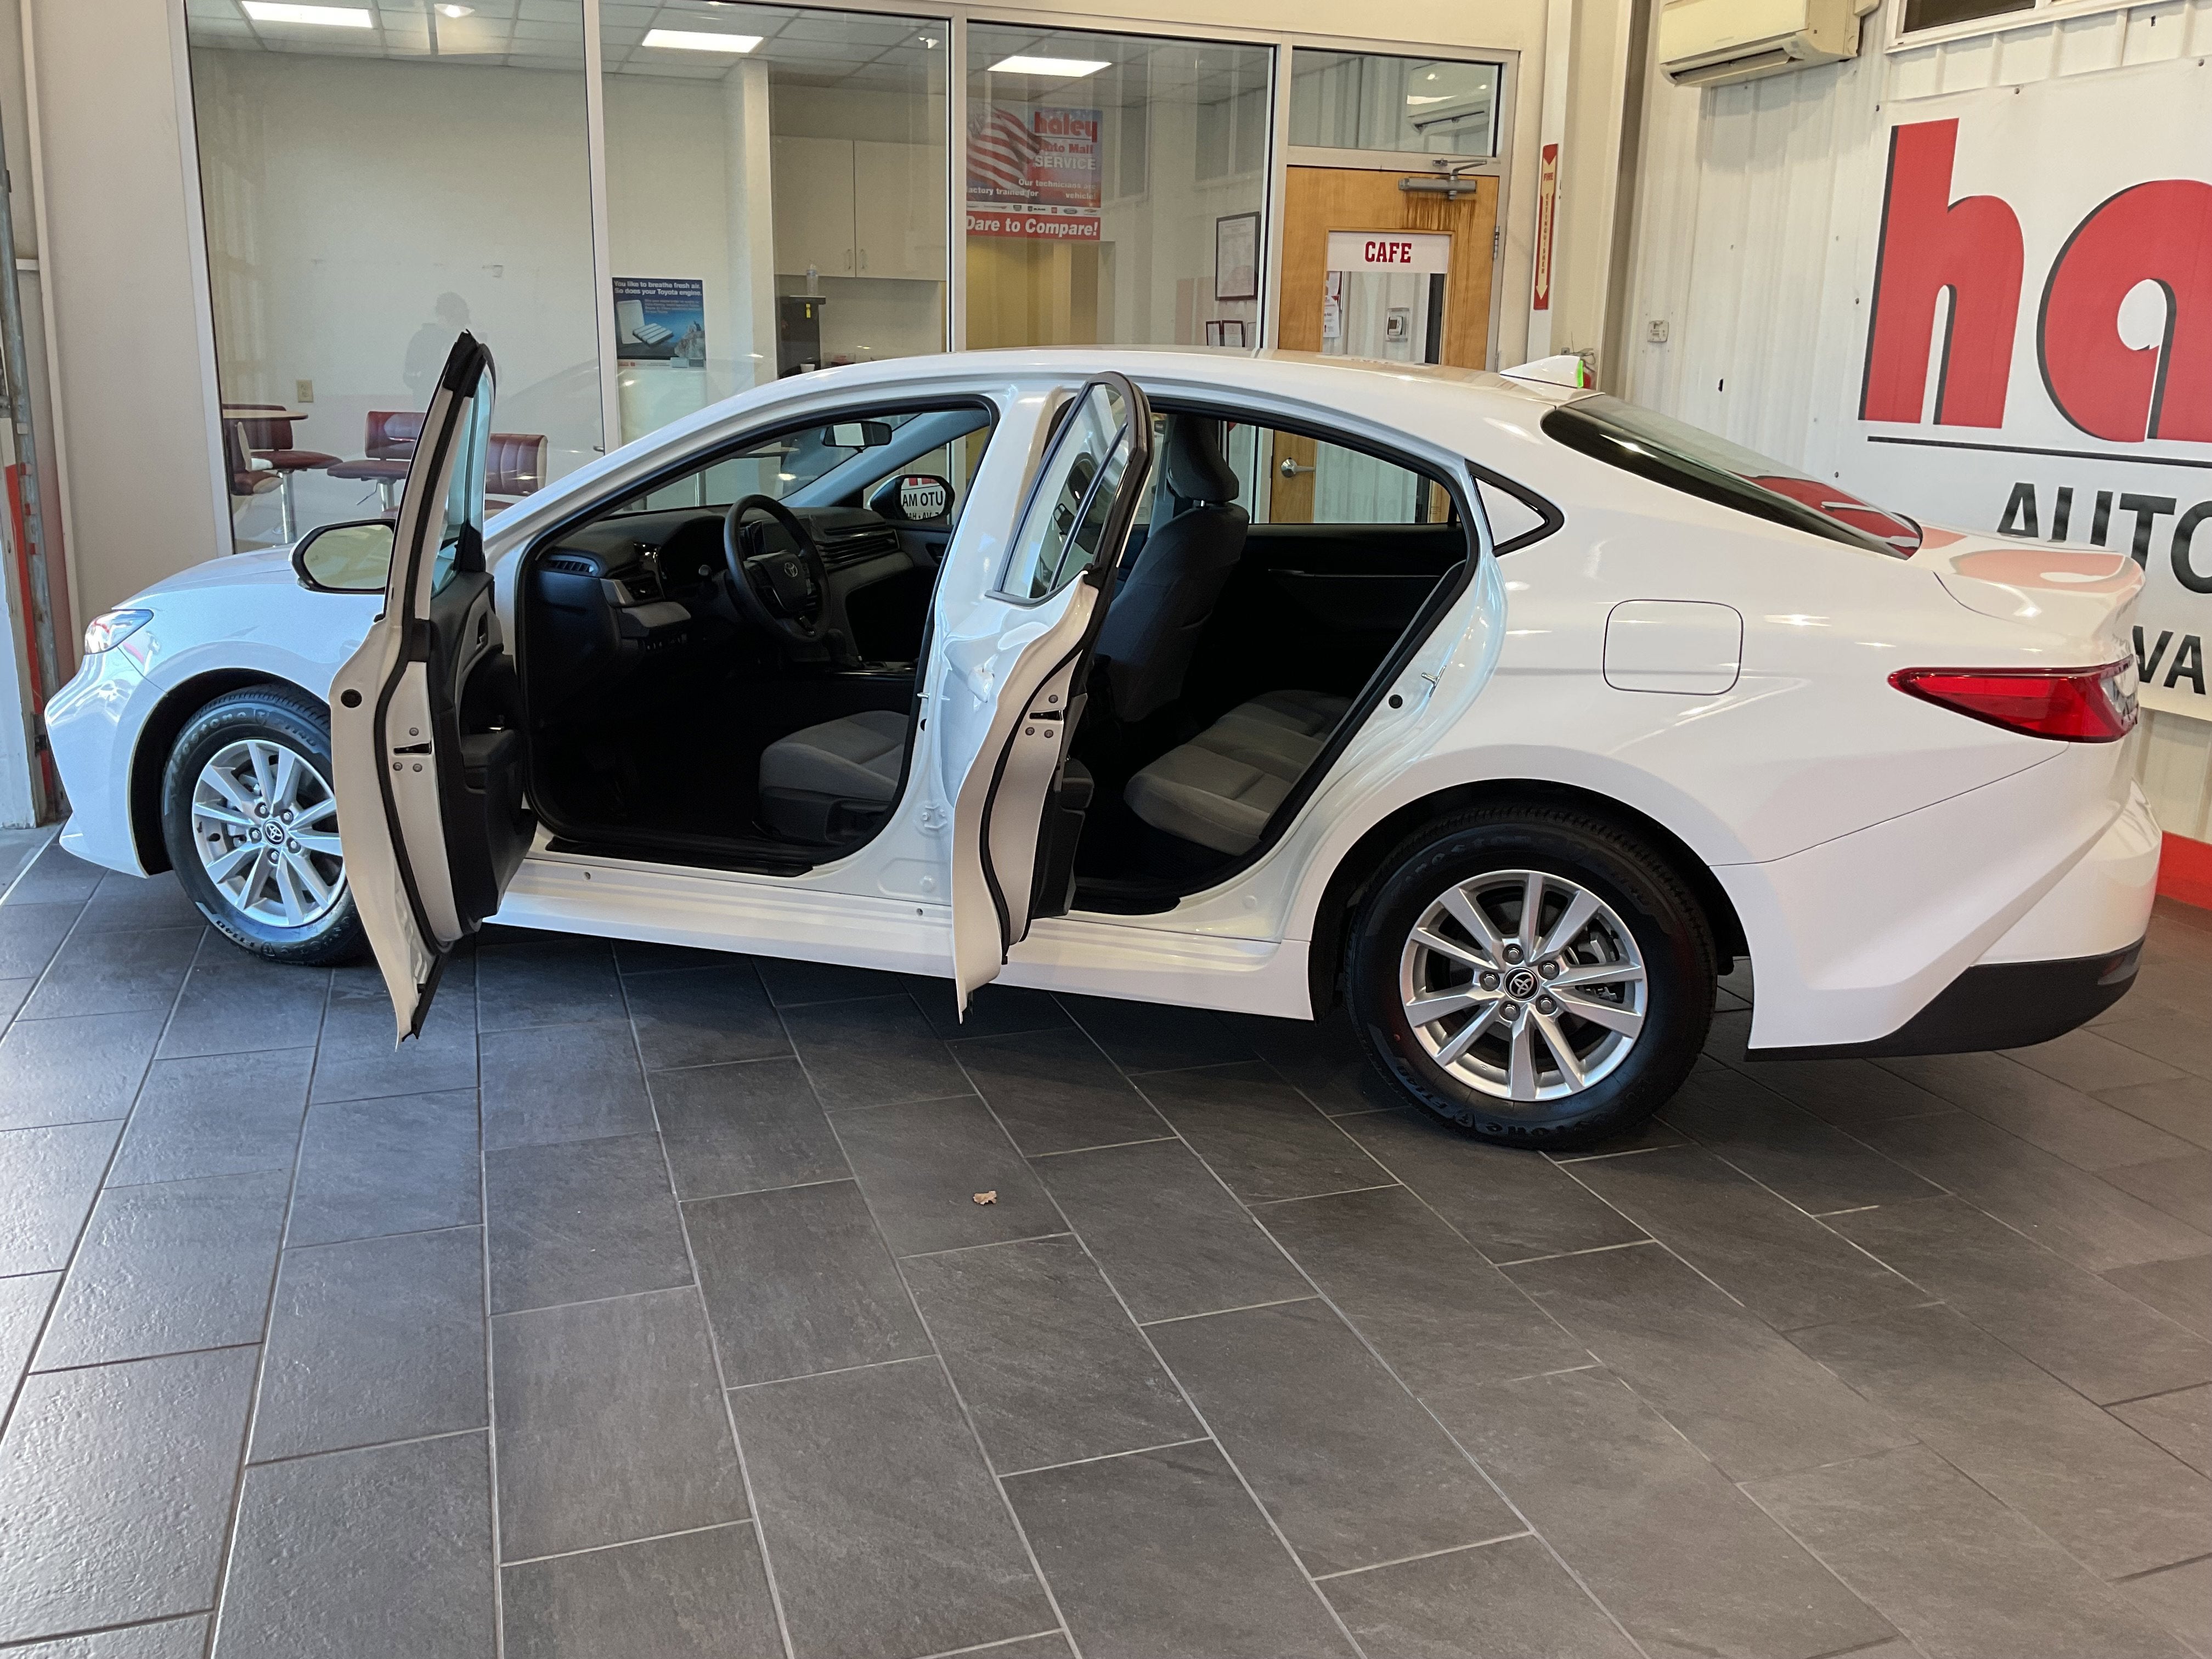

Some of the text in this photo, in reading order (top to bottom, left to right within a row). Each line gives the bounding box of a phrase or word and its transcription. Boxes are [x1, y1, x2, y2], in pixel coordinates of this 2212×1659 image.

[1035, 111, 1098, 143] haley
[1069, 144, 1093, 154] Mall
[1034, 155, 1096, 170] SERVICE
[1019, 179, 1032, 187] Our
[1036, 179, 1080, 189] technicians
[1543, 172, 1554, 180] FIRE
[996, 188, 1025, 196] trained
[1028, 190, 1039, 198] for
[966, 216, 1098, 238] Dare to Compare!
[1541, 193, 1549, 274] EXTINGUISHER
[1365, 241, 1412, 263] CAFE
[1858, 118, 2212, 443] ha
[2132, 625, 2207, 695] VA
